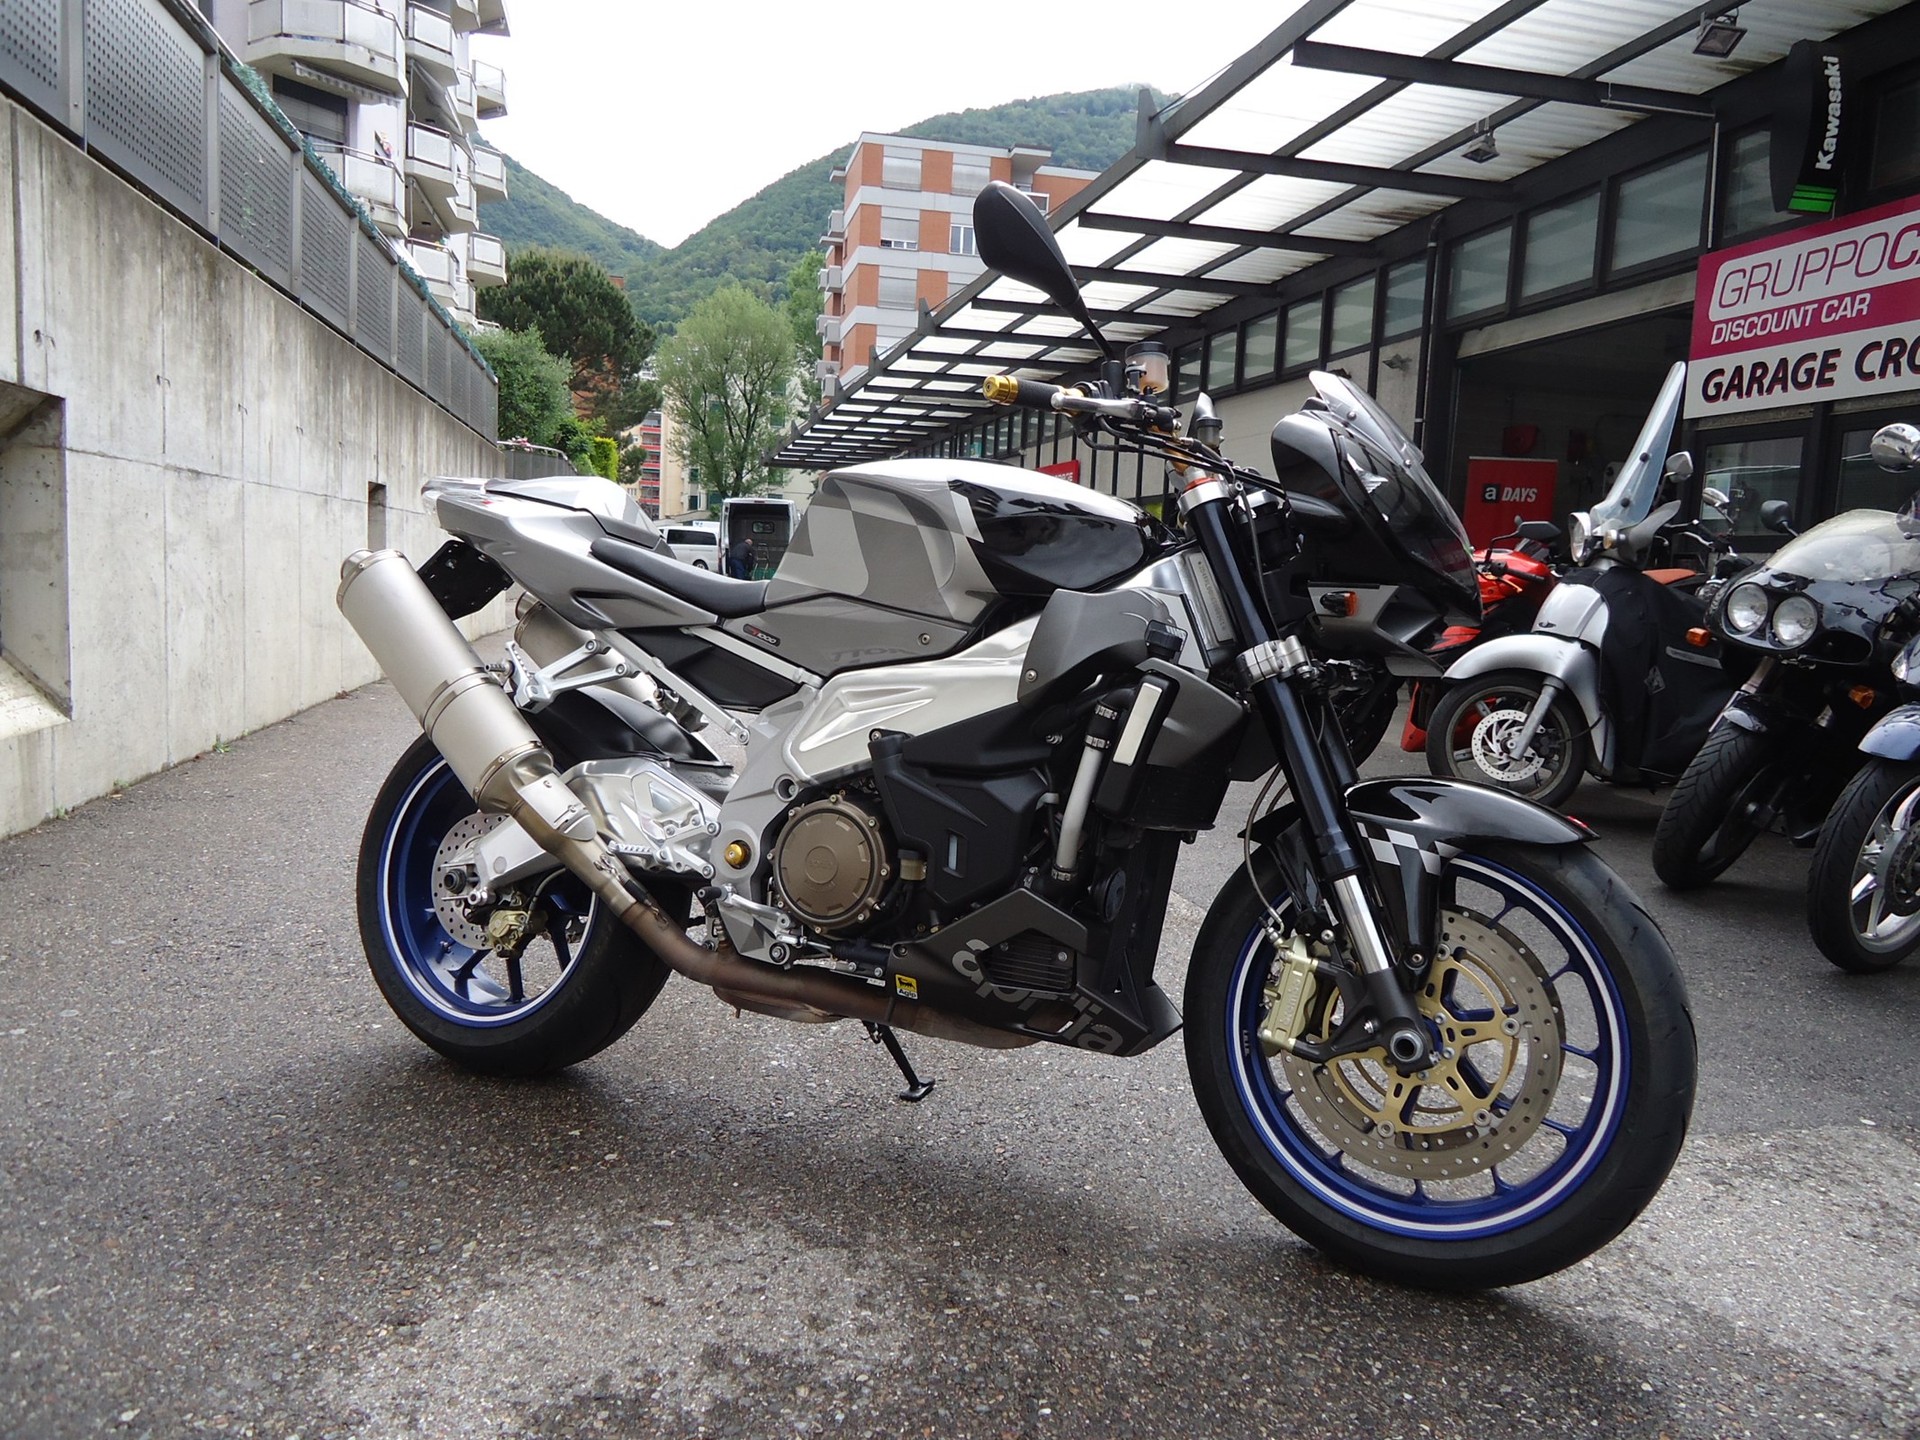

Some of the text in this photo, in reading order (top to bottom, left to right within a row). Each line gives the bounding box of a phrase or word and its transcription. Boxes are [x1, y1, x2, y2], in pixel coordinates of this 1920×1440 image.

[1815, 55, 1842, 170] Kawasaki
[1718, 222, 1920, 308] GRUPPOC
[1711, 293, 1871, 345] DISCOUNT CAR
[1702, 348, 1842, 403] GARAGE
[1502, 487, 1538, 503] DAYS
